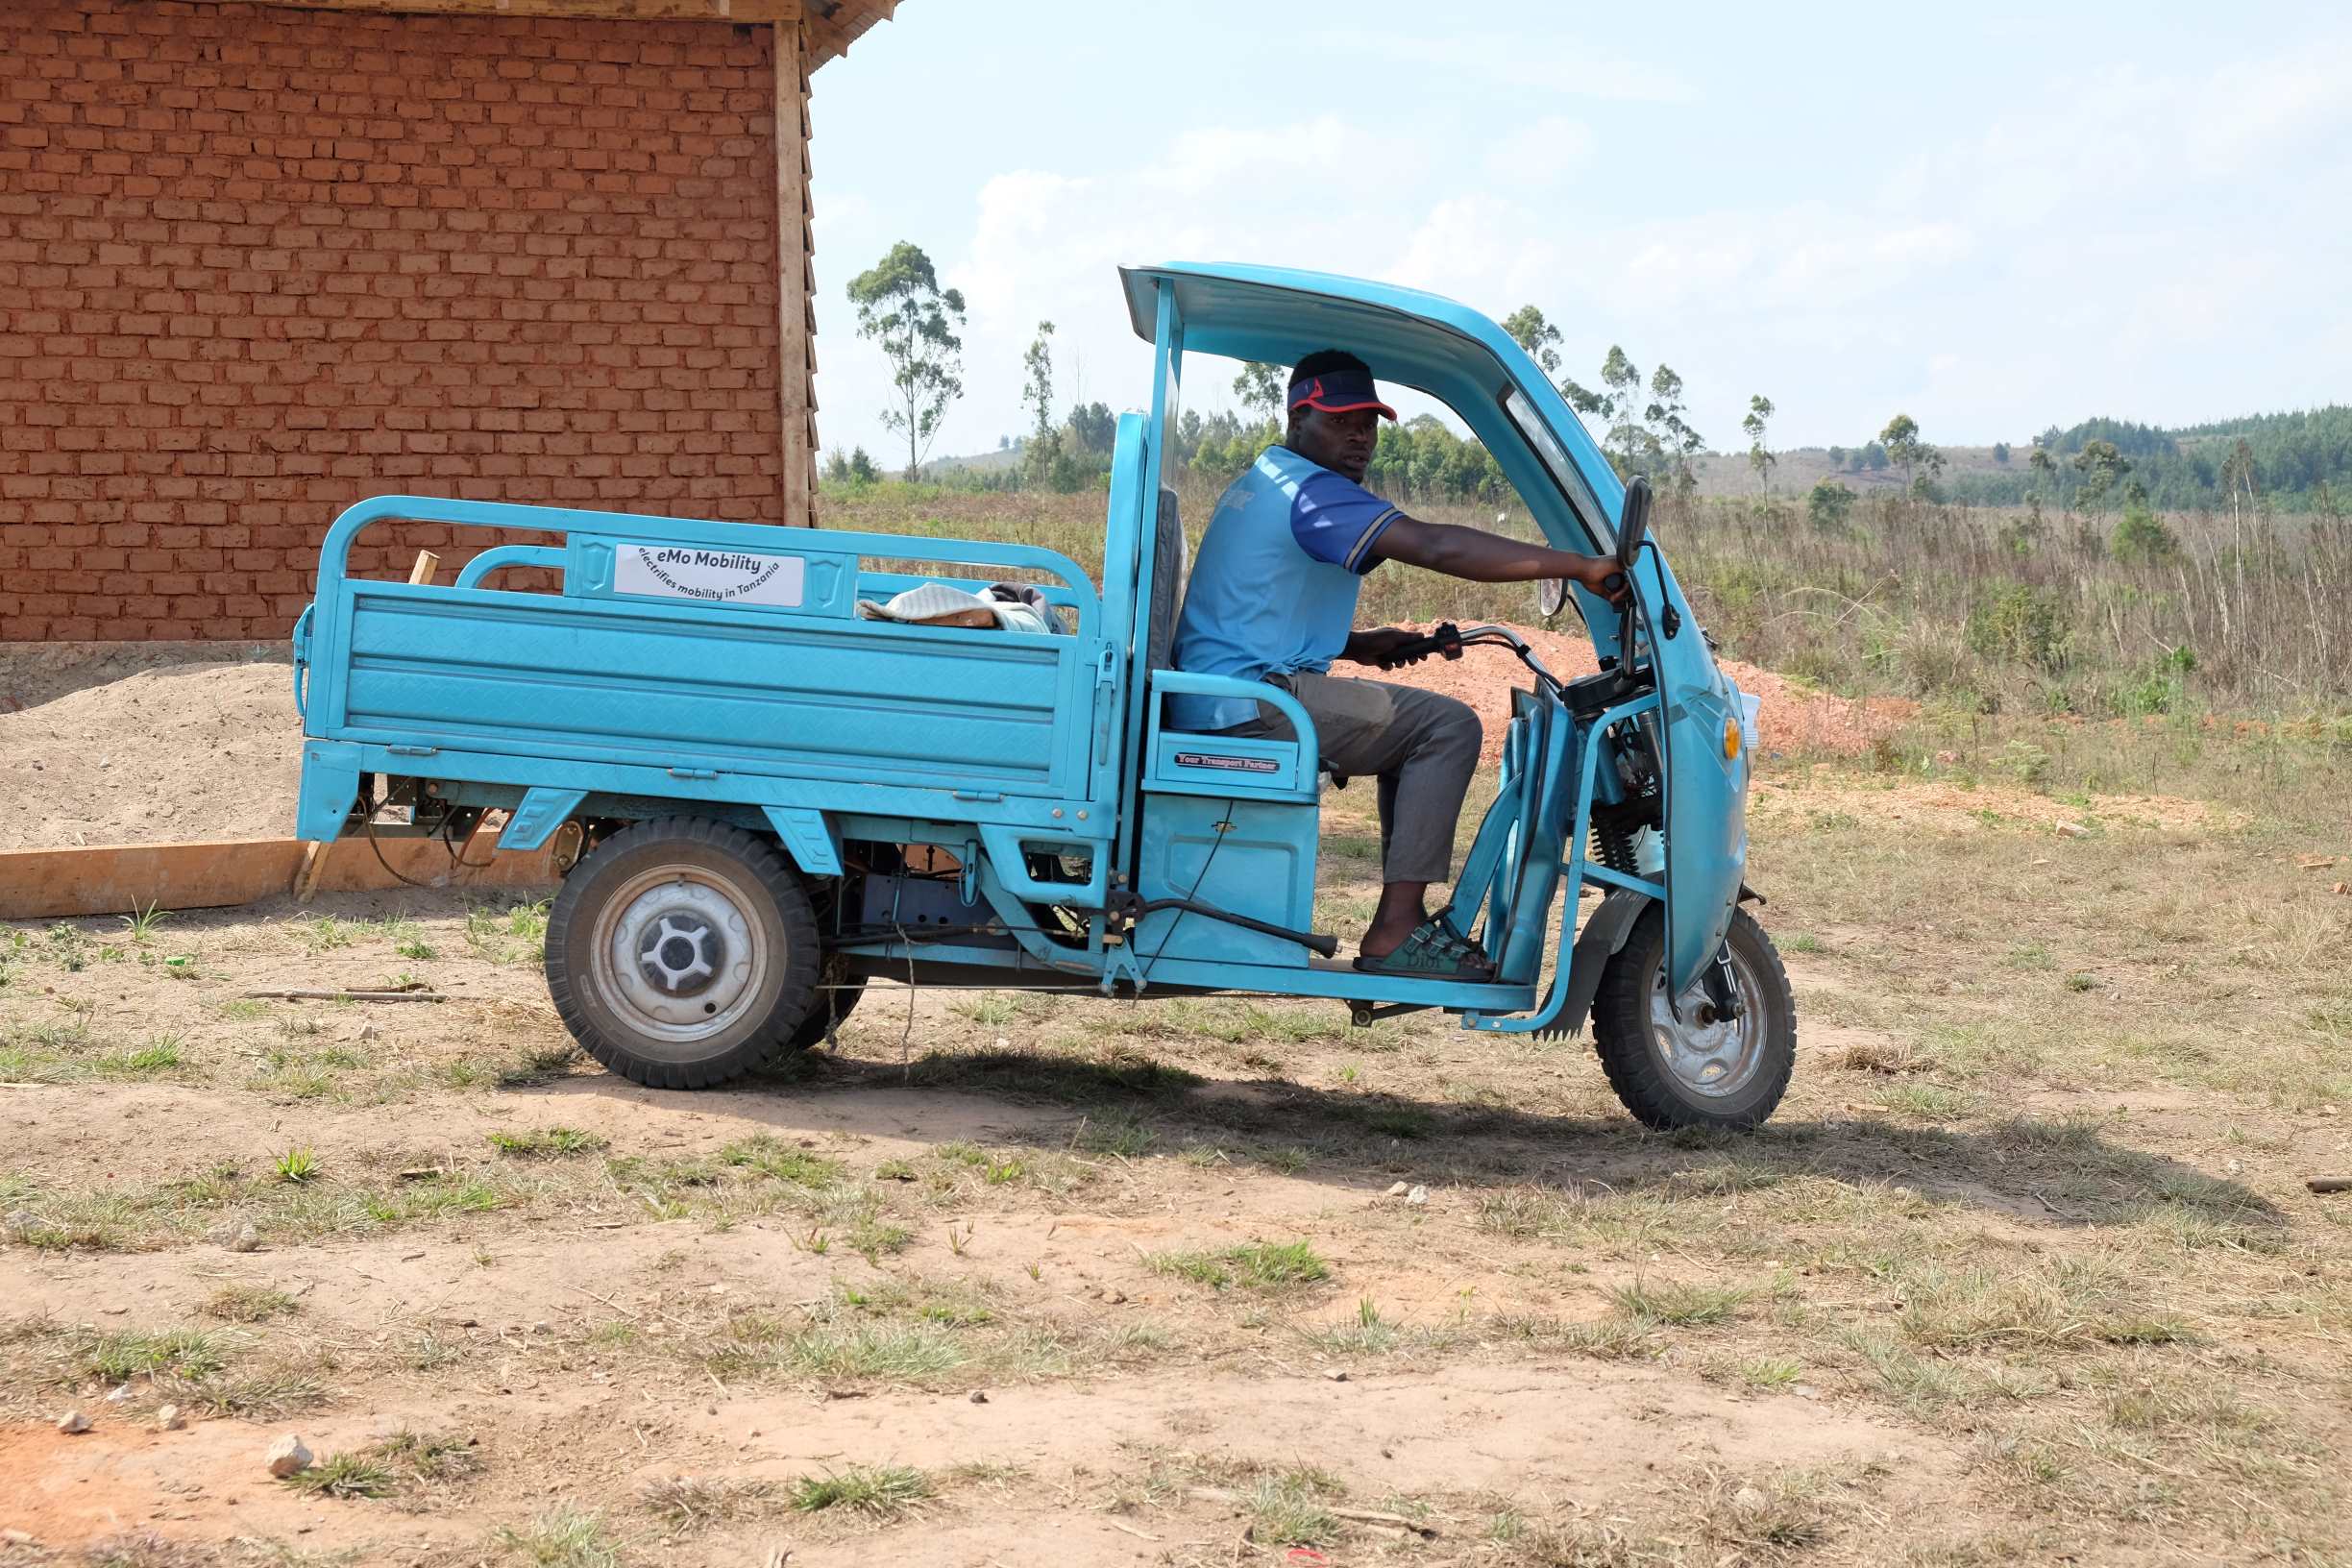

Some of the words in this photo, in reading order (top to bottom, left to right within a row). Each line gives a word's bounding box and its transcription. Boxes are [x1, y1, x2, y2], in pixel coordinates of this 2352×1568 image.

[639, 547, 676, 589] electrifies
[677, 584, 723, 600] mobility
[725, 589, 736, 599] in
[737, 562, 780, 595] Tanzania
[657, 549, 691, 565] eMo
[695, 551, 761, 574] Mobility
[1179, 754, 1200, 764] Your
[1202, 757, 1242, 767] Transport
[1244, 760, 1277, 770] Partner
